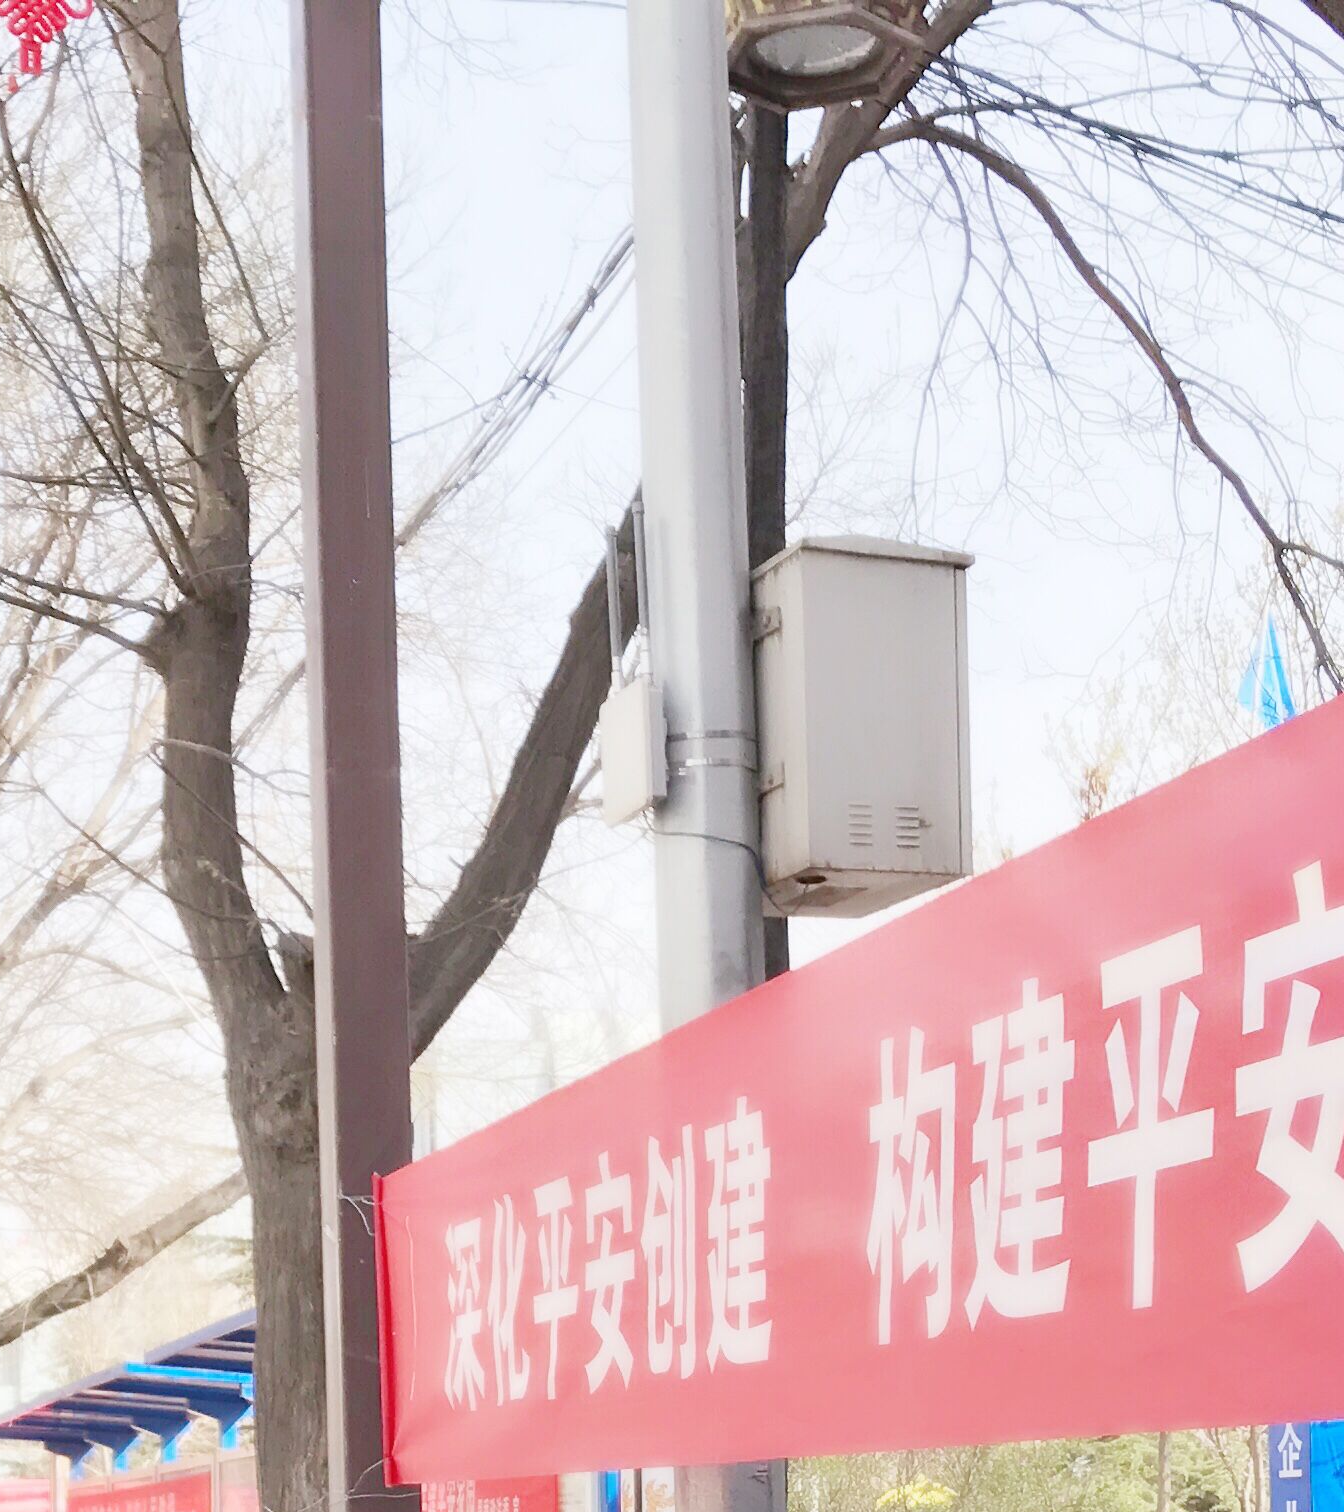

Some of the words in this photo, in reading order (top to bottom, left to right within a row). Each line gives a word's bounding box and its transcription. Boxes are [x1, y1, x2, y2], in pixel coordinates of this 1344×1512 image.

[444, 1094, 773, 1412] 深化平安创建
